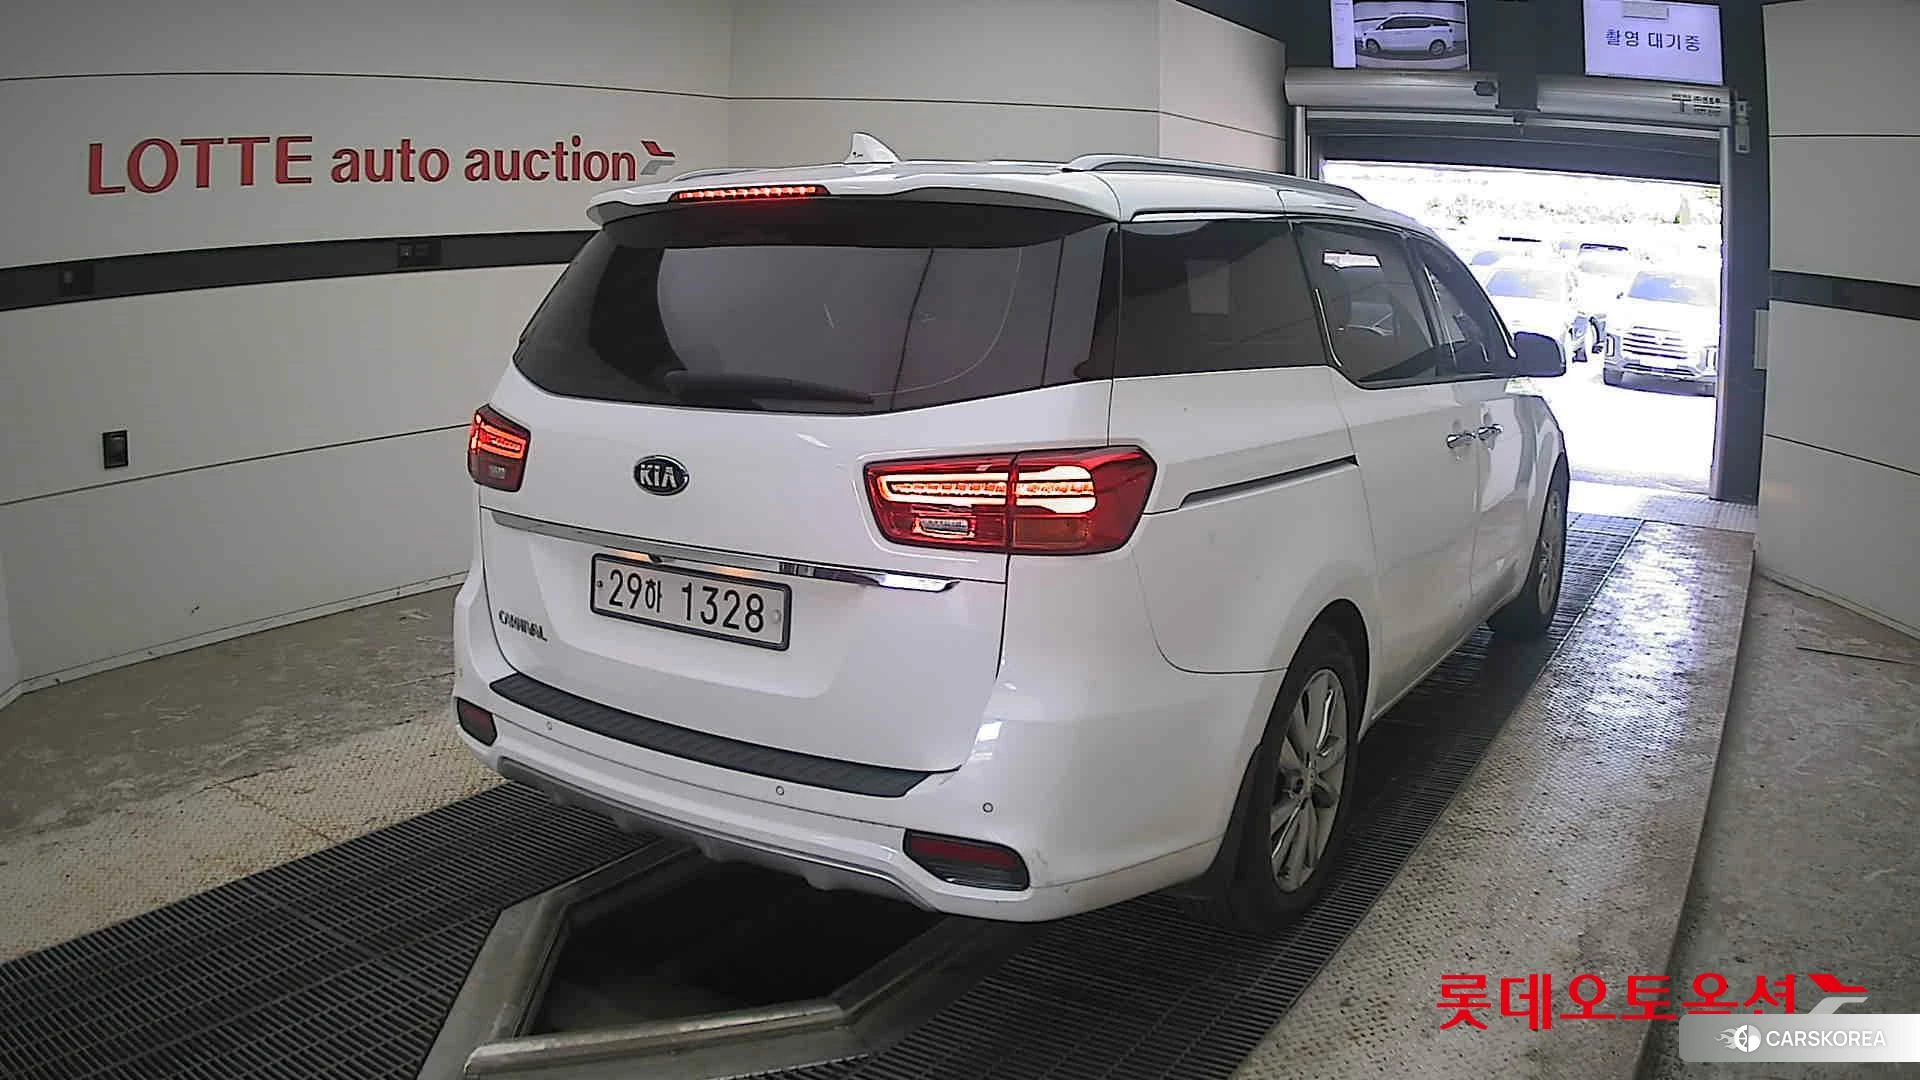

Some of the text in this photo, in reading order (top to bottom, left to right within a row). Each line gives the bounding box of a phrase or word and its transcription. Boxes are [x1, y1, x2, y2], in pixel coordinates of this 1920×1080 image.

[1605, 28, 1701, 52] 촬영 대기중
[88, 135, 637, 195] LOTTE auto auction
[639, 463, 679, 489] KIA
[608, 568, 766, 633] 29하 1328
